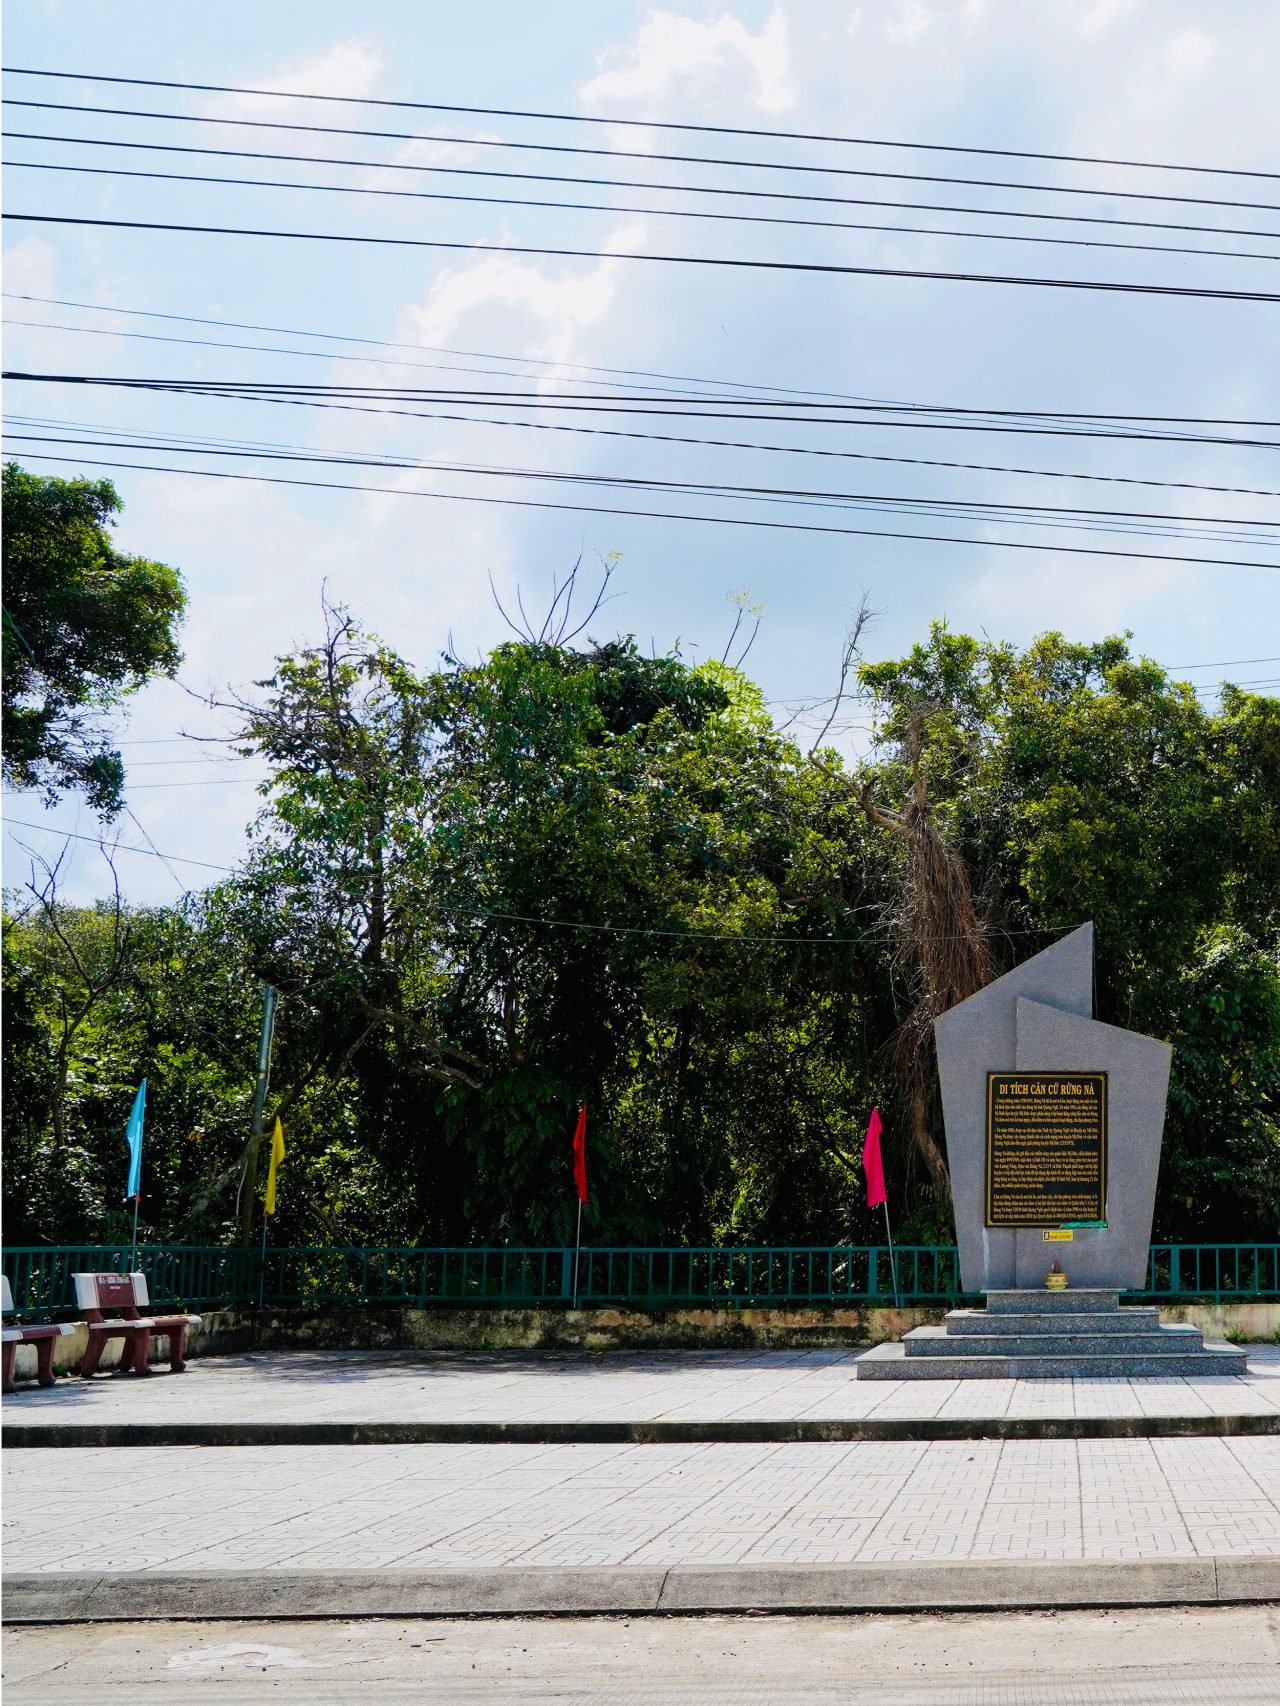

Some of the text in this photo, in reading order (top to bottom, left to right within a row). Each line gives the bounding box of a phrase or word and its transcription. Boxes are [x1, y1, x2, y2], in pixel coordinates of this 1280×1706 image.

[1000, 1084, 1008, 1094] DI
[1010, 1082, 1028, 1094] TÍCH
[1030, 1082, 1046, 1094] CĂN
[1048, 1082, 1059, 1094] CỨ
[1061, 1082, 1082, 1094] RỪNG
